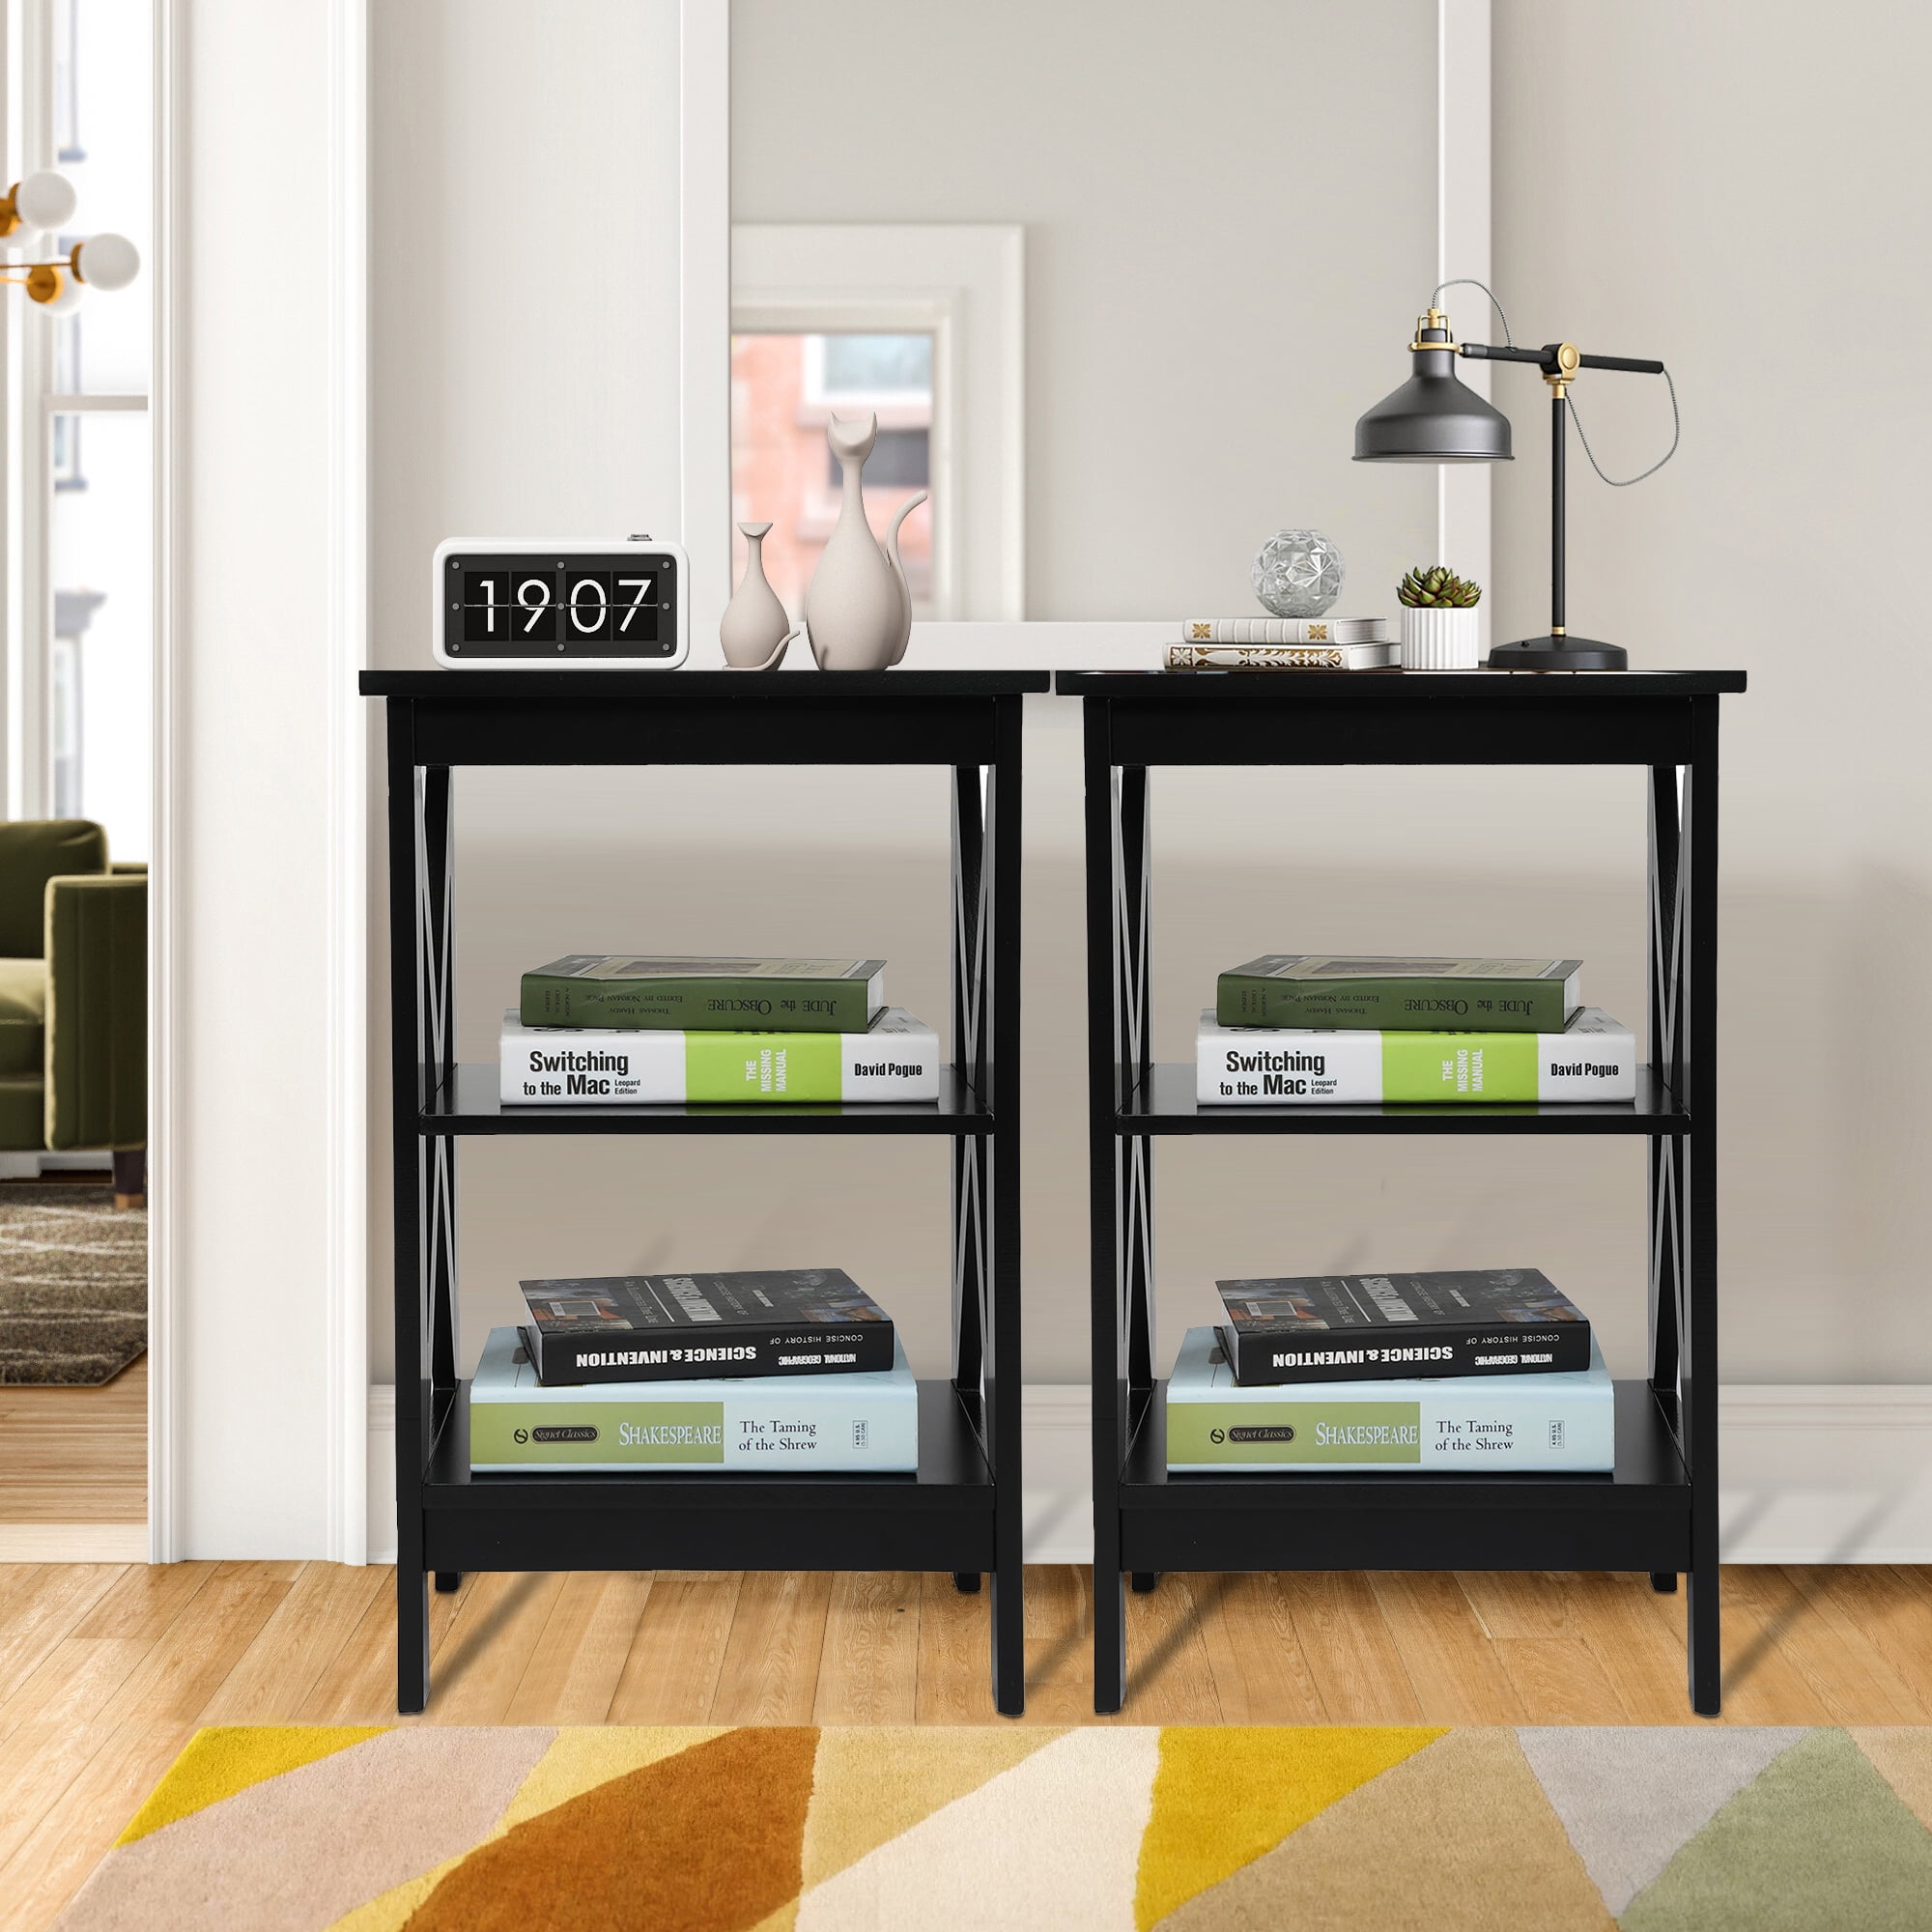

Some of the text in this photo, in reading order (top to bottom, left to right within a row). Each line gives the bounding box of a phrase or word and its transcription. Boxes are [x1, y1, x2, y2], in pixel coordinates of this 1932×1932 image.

[708, 999, 837, 1015] JUDE the OBSCURE
[1405, 999, 1533, 1015] JUDE the OBSCURE
[529, 1050, 629, 1075] Switching
[746, 1060, 756, 1081] THE
[761, 1049, 771, 1092] MISSING
[776, 1049, 786, 1092] MANUAL
[855, 1063, 923, 1078] David Pogue
[1226, 1050, 1325, 1075] Switching
[1442, 1060, 1453, 1081] THE
[1458, 1049, 1467, 1092] MISSING
[1472, 1049, 1483, 1092] MANUAL
[1551, 1063, 1619, 1078] David Pogue
[523, 1074, 610, 1095] to the Mac
[614, 1079, 640, 1088] Leopard
[1219, 1074, 1306, 1095] to the Mac
[1311, 1079, 1337, 1088] Leopard
[826, 1334, 864, 1343] CONCISE
[1522, 1334, 1560, 1343] CONCISE
[619, 1422, 723, 1445] SHAKESPEARE
[739, 1420, 816, 1436] The Taming
[1316, 1422, 1419, 1445] SHAKESPEARE
[1435, 1420, 1513, 1436] The Taming
[739, 1437, 817, 1451] of the Shrew
[1435, 1437, 1514, 1451] of the Shrew
